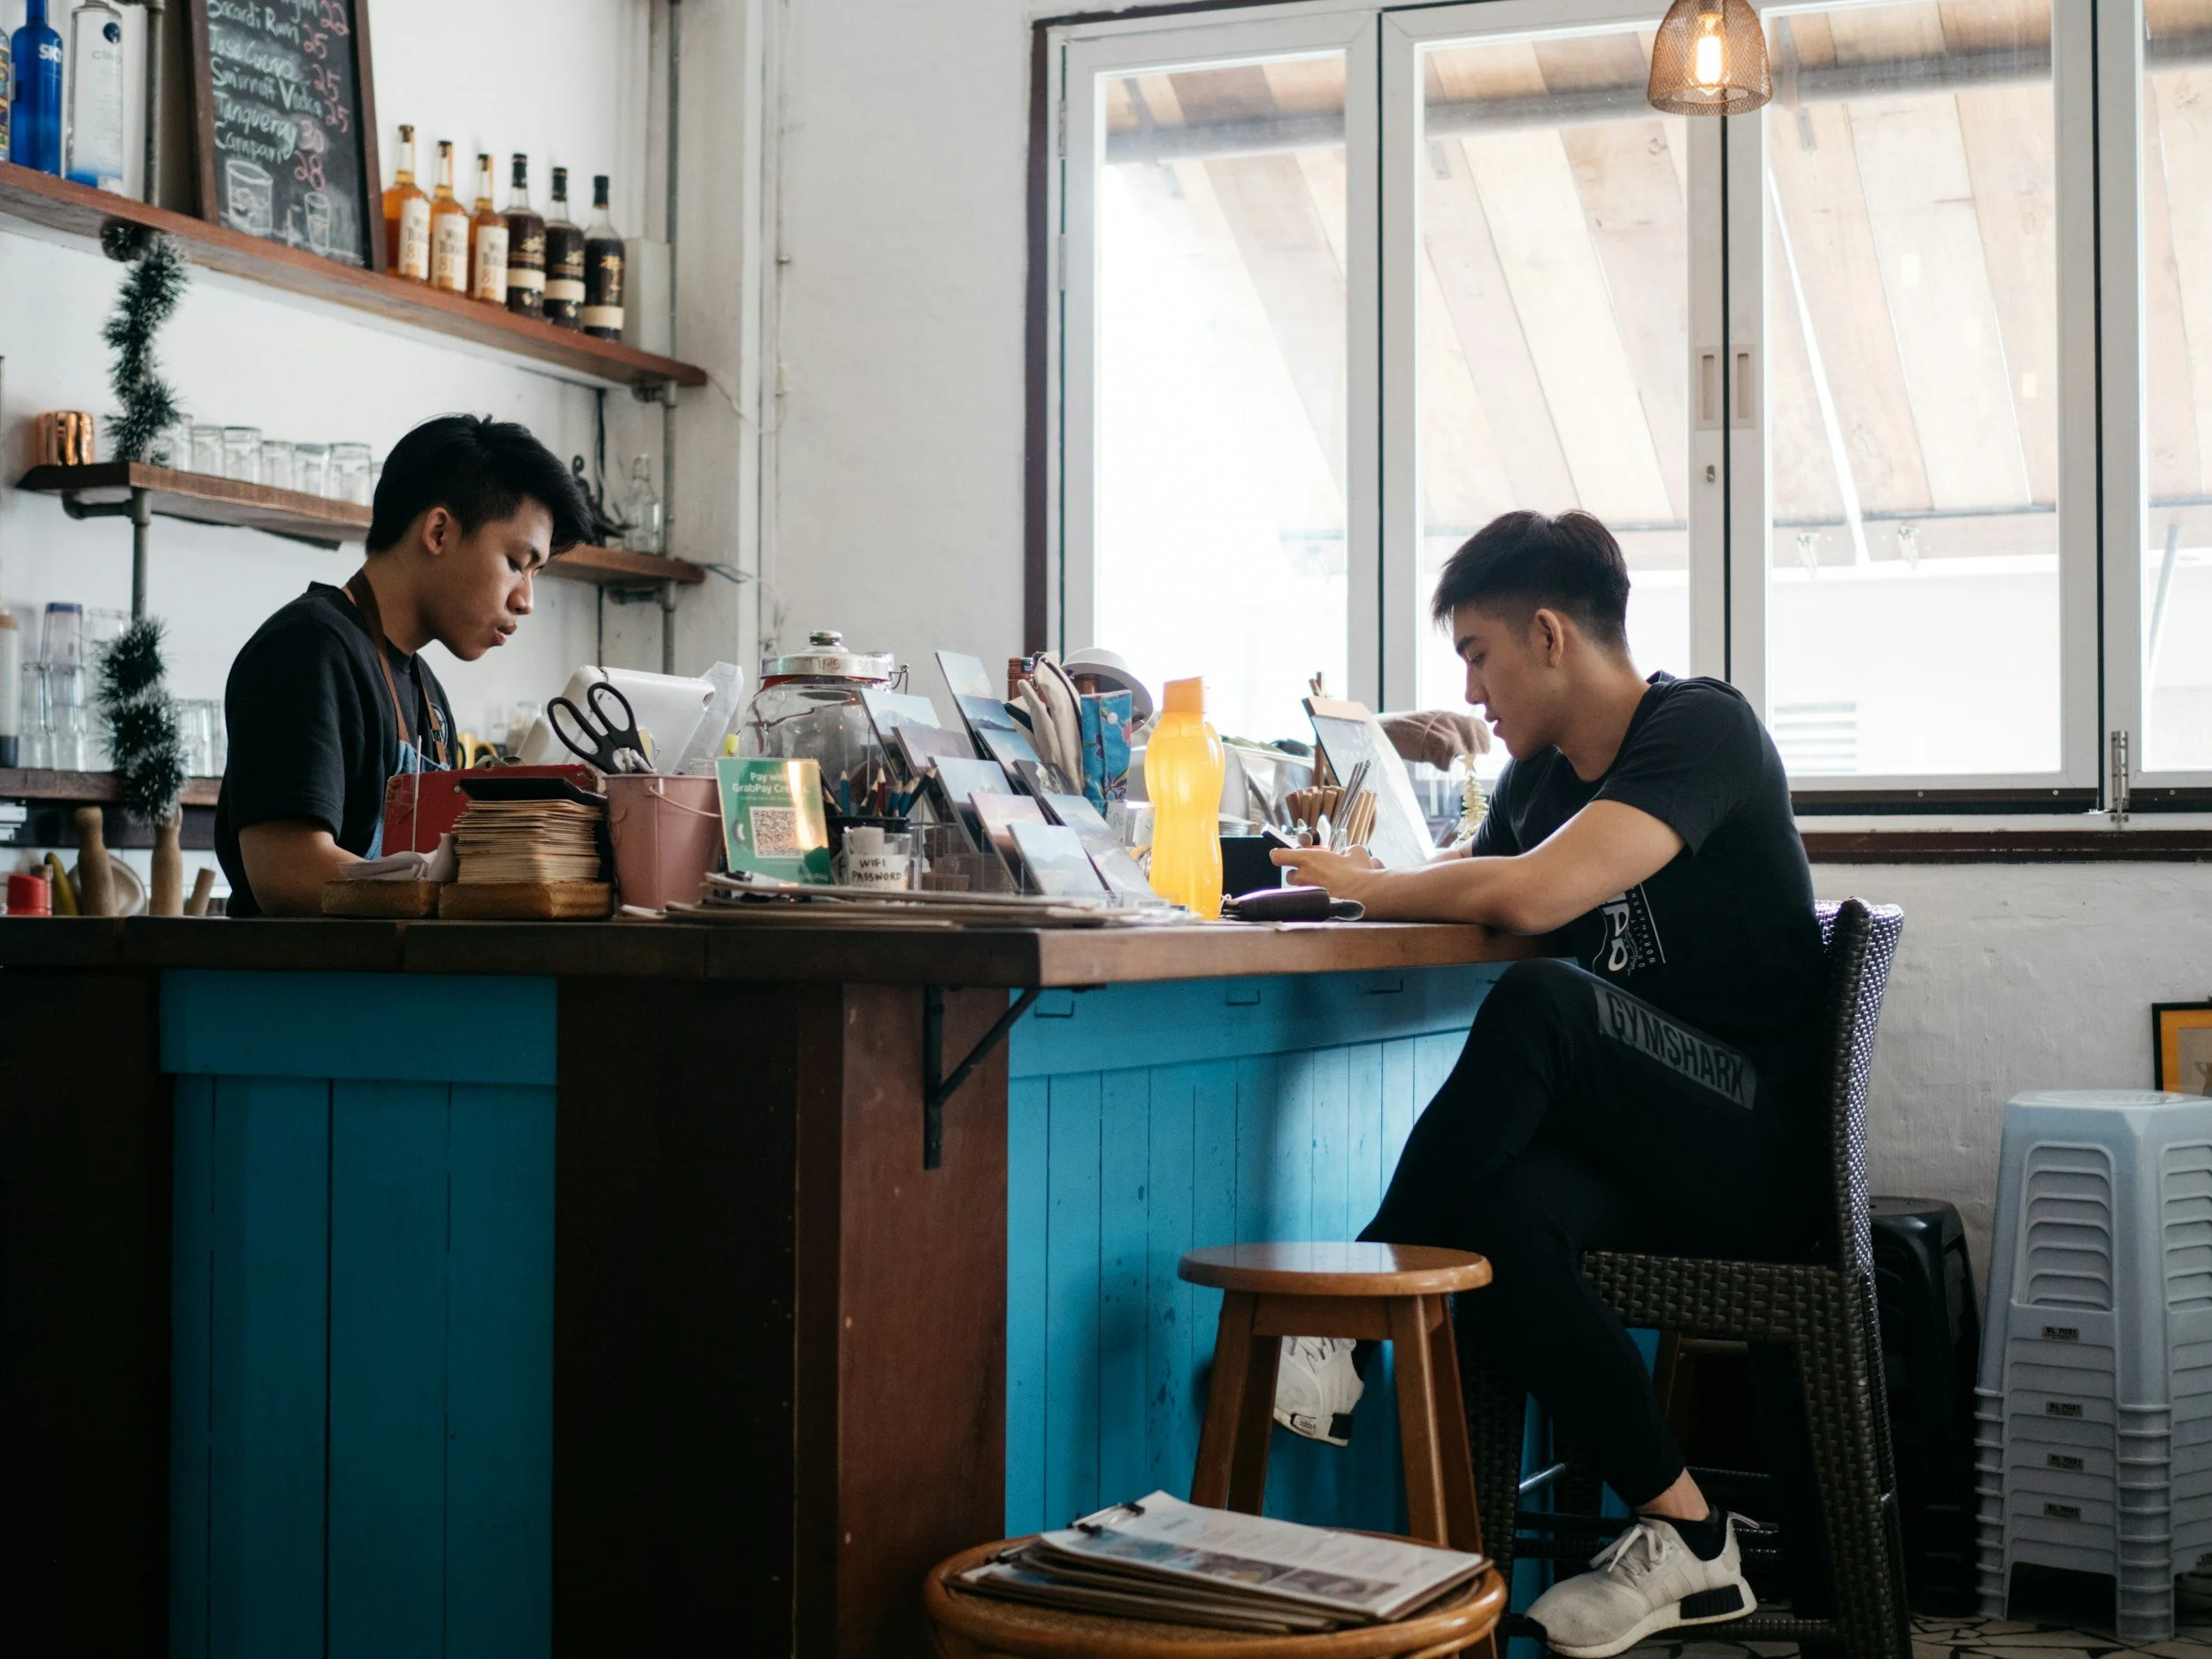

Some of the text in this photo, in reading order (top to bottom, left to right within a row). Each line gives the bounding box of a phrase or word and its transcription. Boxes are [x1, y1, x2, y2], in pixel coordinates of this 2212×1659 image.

[294, 149, 326, 192] 28
[749, 772, 768, 783] Pay
[733, 783, 772, 795] GrabPay
[859, 858, 886, 868] WIFI
[851, 870, 902, 882] PASSWORD
[1631, 886, 1656, 964] WORKMANSH
[1605, 990, 1743, 1105] GYMSHARK
